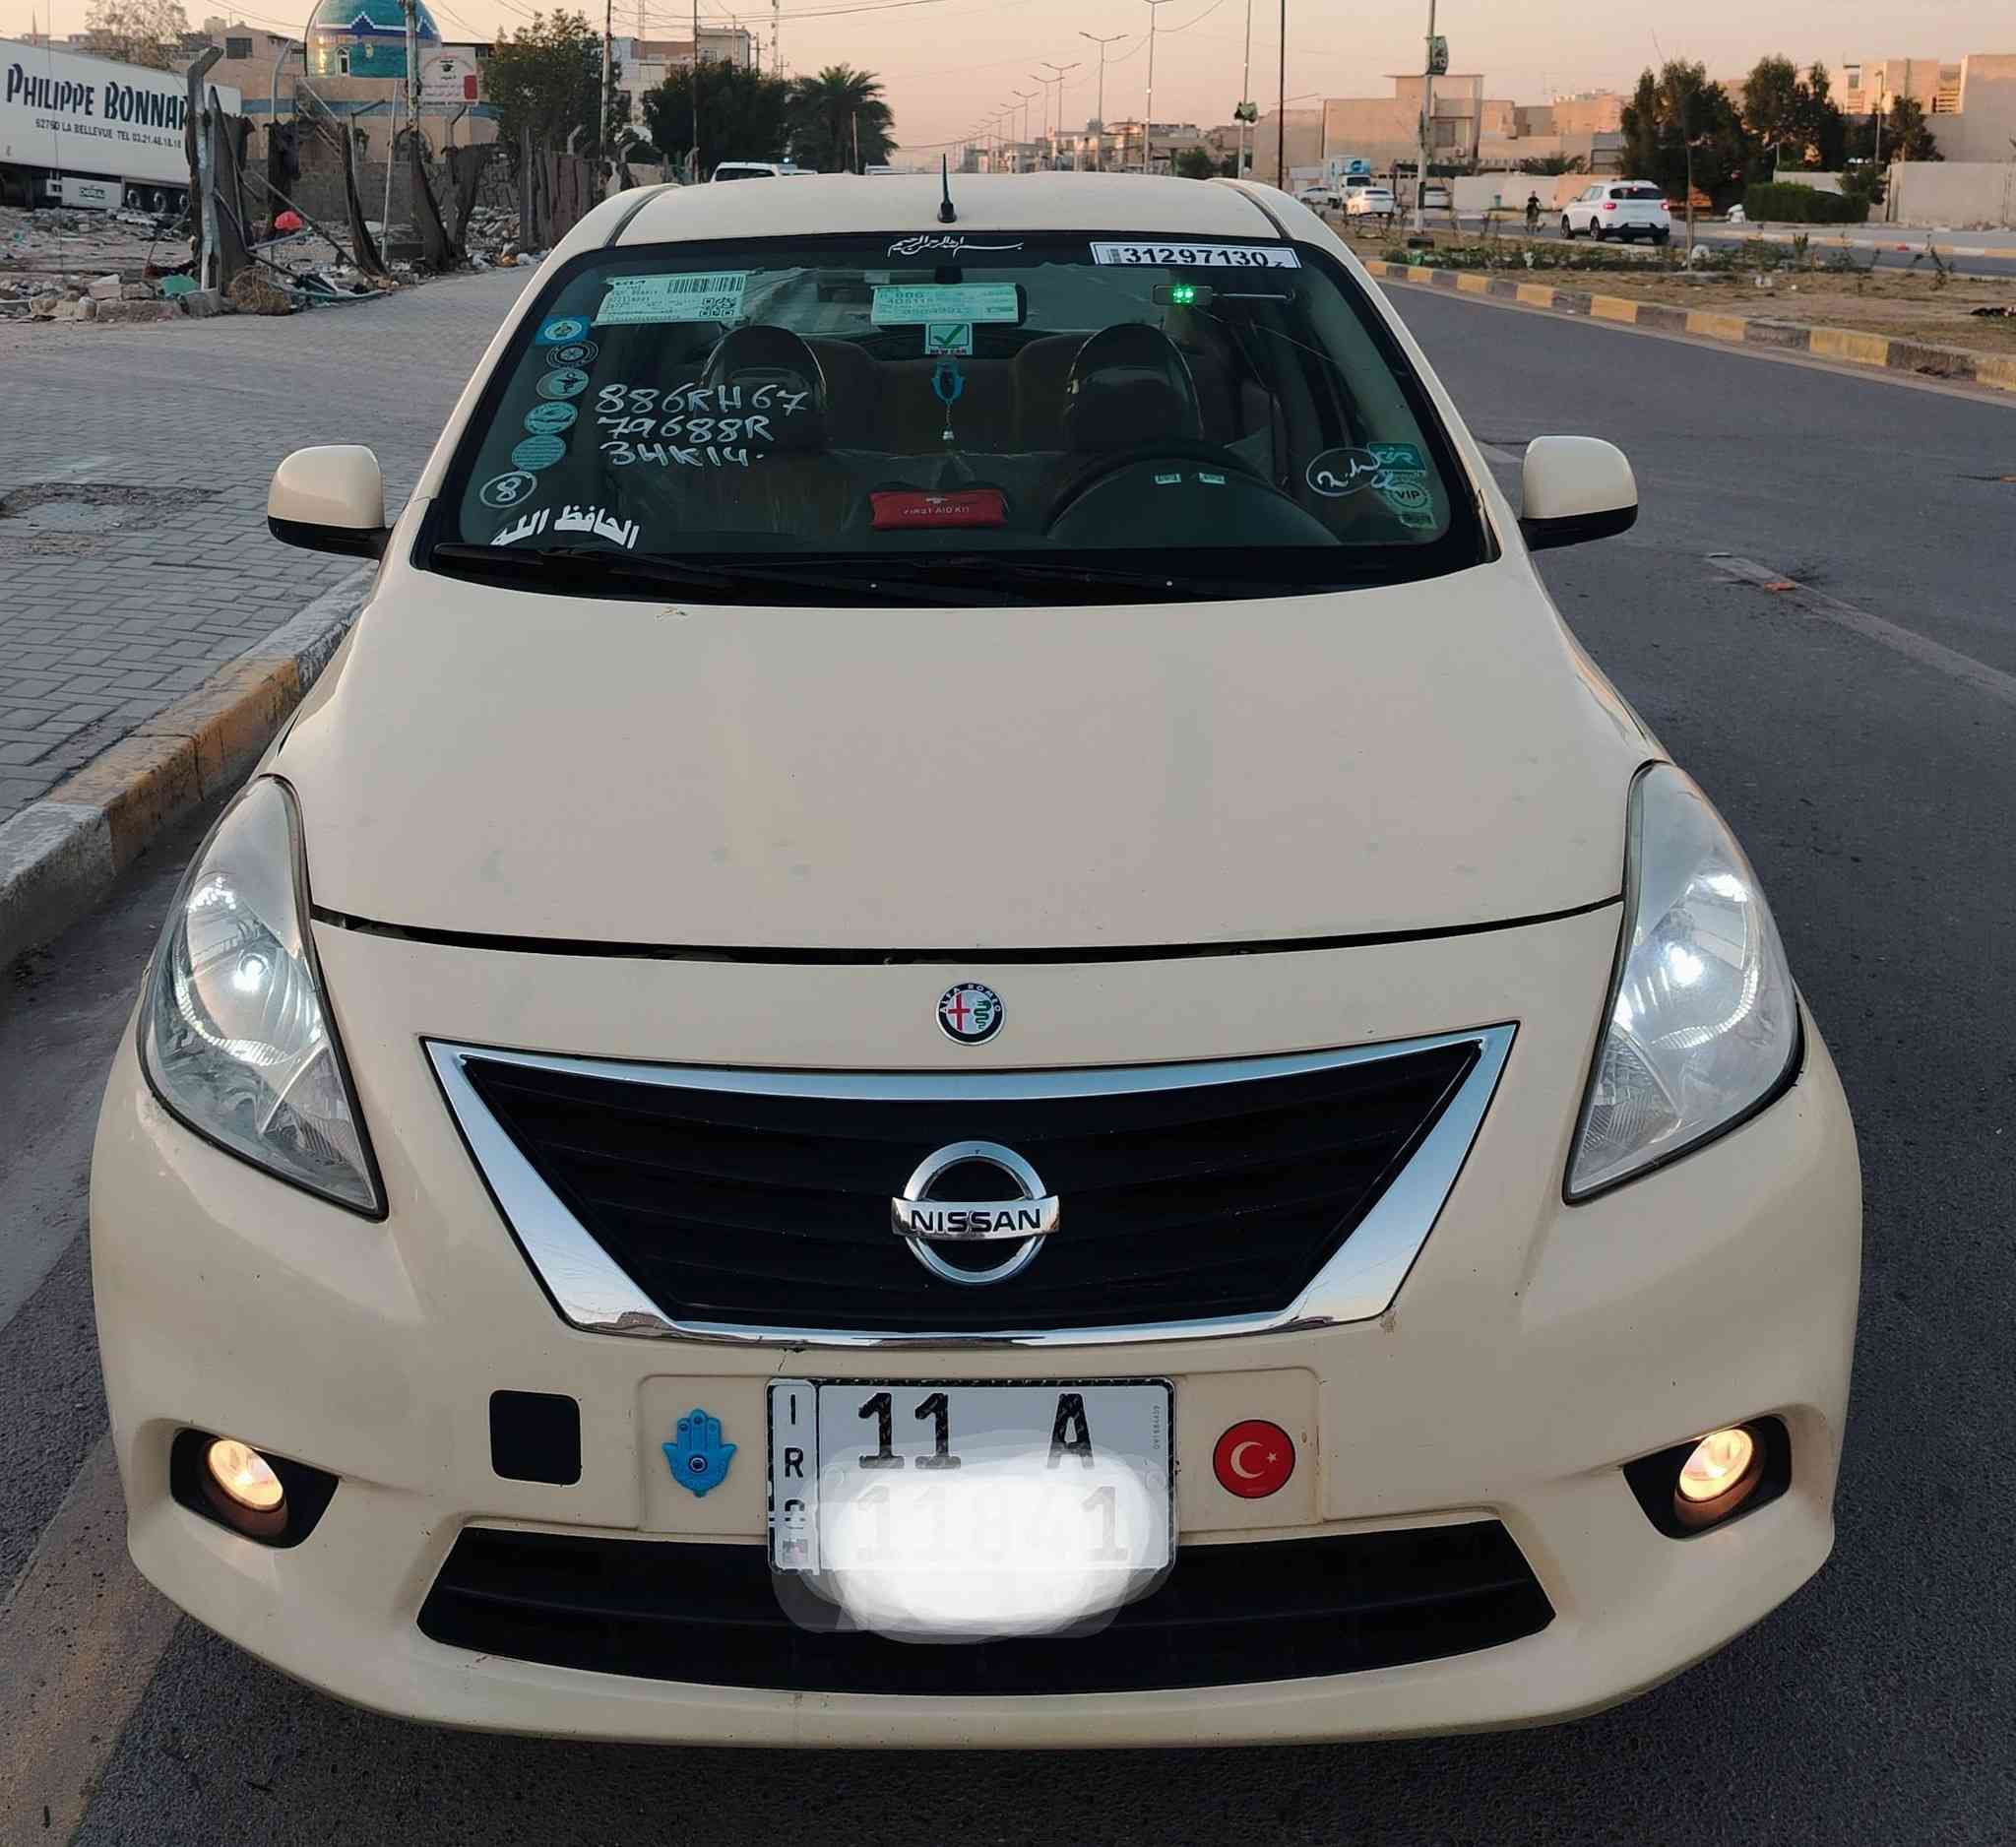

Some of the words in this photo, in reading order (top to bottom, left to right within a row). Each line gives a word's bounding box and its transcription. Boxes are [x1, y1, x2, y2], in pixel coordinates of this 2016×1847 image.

[6, 63, 95, 116] PHILIPPE
[61, 122, 72, 133] LA
[74, 124, 113, 140] BELLEVUE
[117, 130, 130, 142] TEL
[1124, 247, 1269, 267] 31297130
[1395, 490, 1420, 500] VIP
[553, 505, 640, 549] الحافظ
[939, 987, 961, 1013] ALFA
[968, 984, 1001, 1012] ROMEO
[911, 1209, 1041, 1233] NISSAN
[858, 1392, 962, 1470] 11
[1046, 1392, 1095, 1470] A
